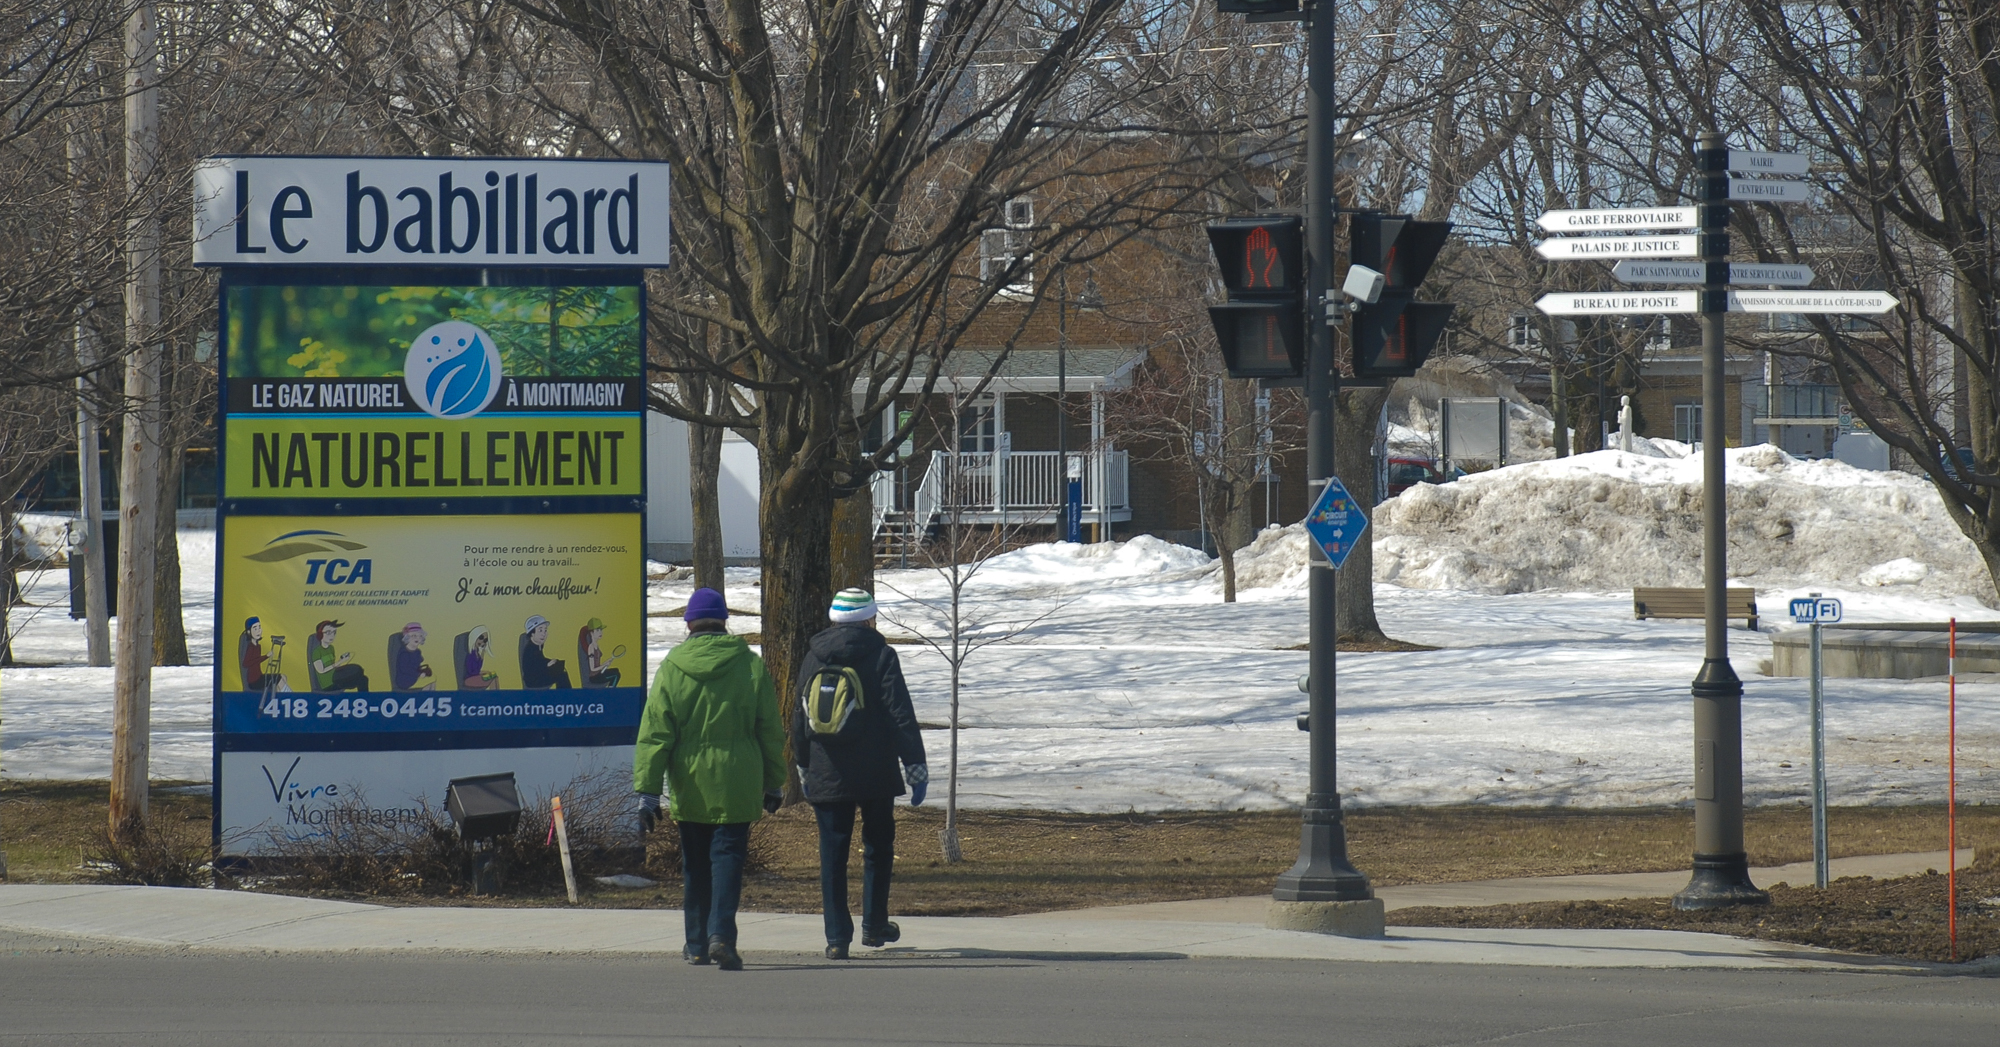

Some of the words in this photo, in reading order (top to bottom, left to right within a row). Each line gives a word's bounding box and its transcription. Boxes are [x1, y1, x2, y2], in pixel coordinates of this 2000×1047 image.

[1750, 157, 1774, 167] MAIRIE
[1737, 184, 1785, 195] CENTRE-VILLE
[236, 170, 312, 254] Le
[346, 170, 638, 254] babillard
[1568, 215, 1600, 225] GARE
[1603, 213, 1683, 224] FERROVIAIRE
[1571, 242, 1611, 253] PALAIS
[1614, 242, 1629, 252] DE
[1632, 241, 1680, 252] JUSTICE
[1631, 266, 1648, 276] PARC
[1650, 267, 1700, 278] SAINT-NICOLAS
[1729, 269, 1748, 279] ENTRE
[1750, 270, 1775, 279] SERVICE
[1777, 270, 1802, 280] CANADA
[1573, 298, 1620, 309] BUREAU
[1623, 298, 1639, 308] DE
[1641, 297, 1679, 307] POSTE
[1731, 297, 1776, 306] COMMISSION
[1777, 297, 1812, 306] SCOLAIRE
[1813, 298, 1823, 306] DE
[1825, 298, 1834, 306] LA
[1835, 296, 1882, 307] CÔTE-DU-SUD
[252, 384, 272, 408] LE
[278, 384, 314, 408] GAZ
[320, 383, 404, 407] NATUREL
[506, 378, 518, 406] À
[523, 383, 624, 406] MONTMAGNY
[252, 431, 624, 488] NATURELLEMENT
[464, 545, 490, 554] Pour
[492, 546, 508, 554] me
[511, 545, 545, 554] rendre
[547, 544, 553, 553] à
[571, 544, 628, 554] rendez-vous,
[464, 558, 470, 567] à
[473, 558, 507, 567] l'école
[511, 559, 524, 567] ou
[526, 559, 539, 567] au
[306, 558, 372, 585] TCA
[401, 588, 430, 596] ADAPTÉ
[455, 577, 489, 603] J'ai
[493, 585, 522, 597] mon
[263, 698, 308, 718] 418
[317, 697, 452, 719] 248-0445
[460, 702, 604, 717] tcamontmagny.ca
[261, 756, 338, 803] Vivre
